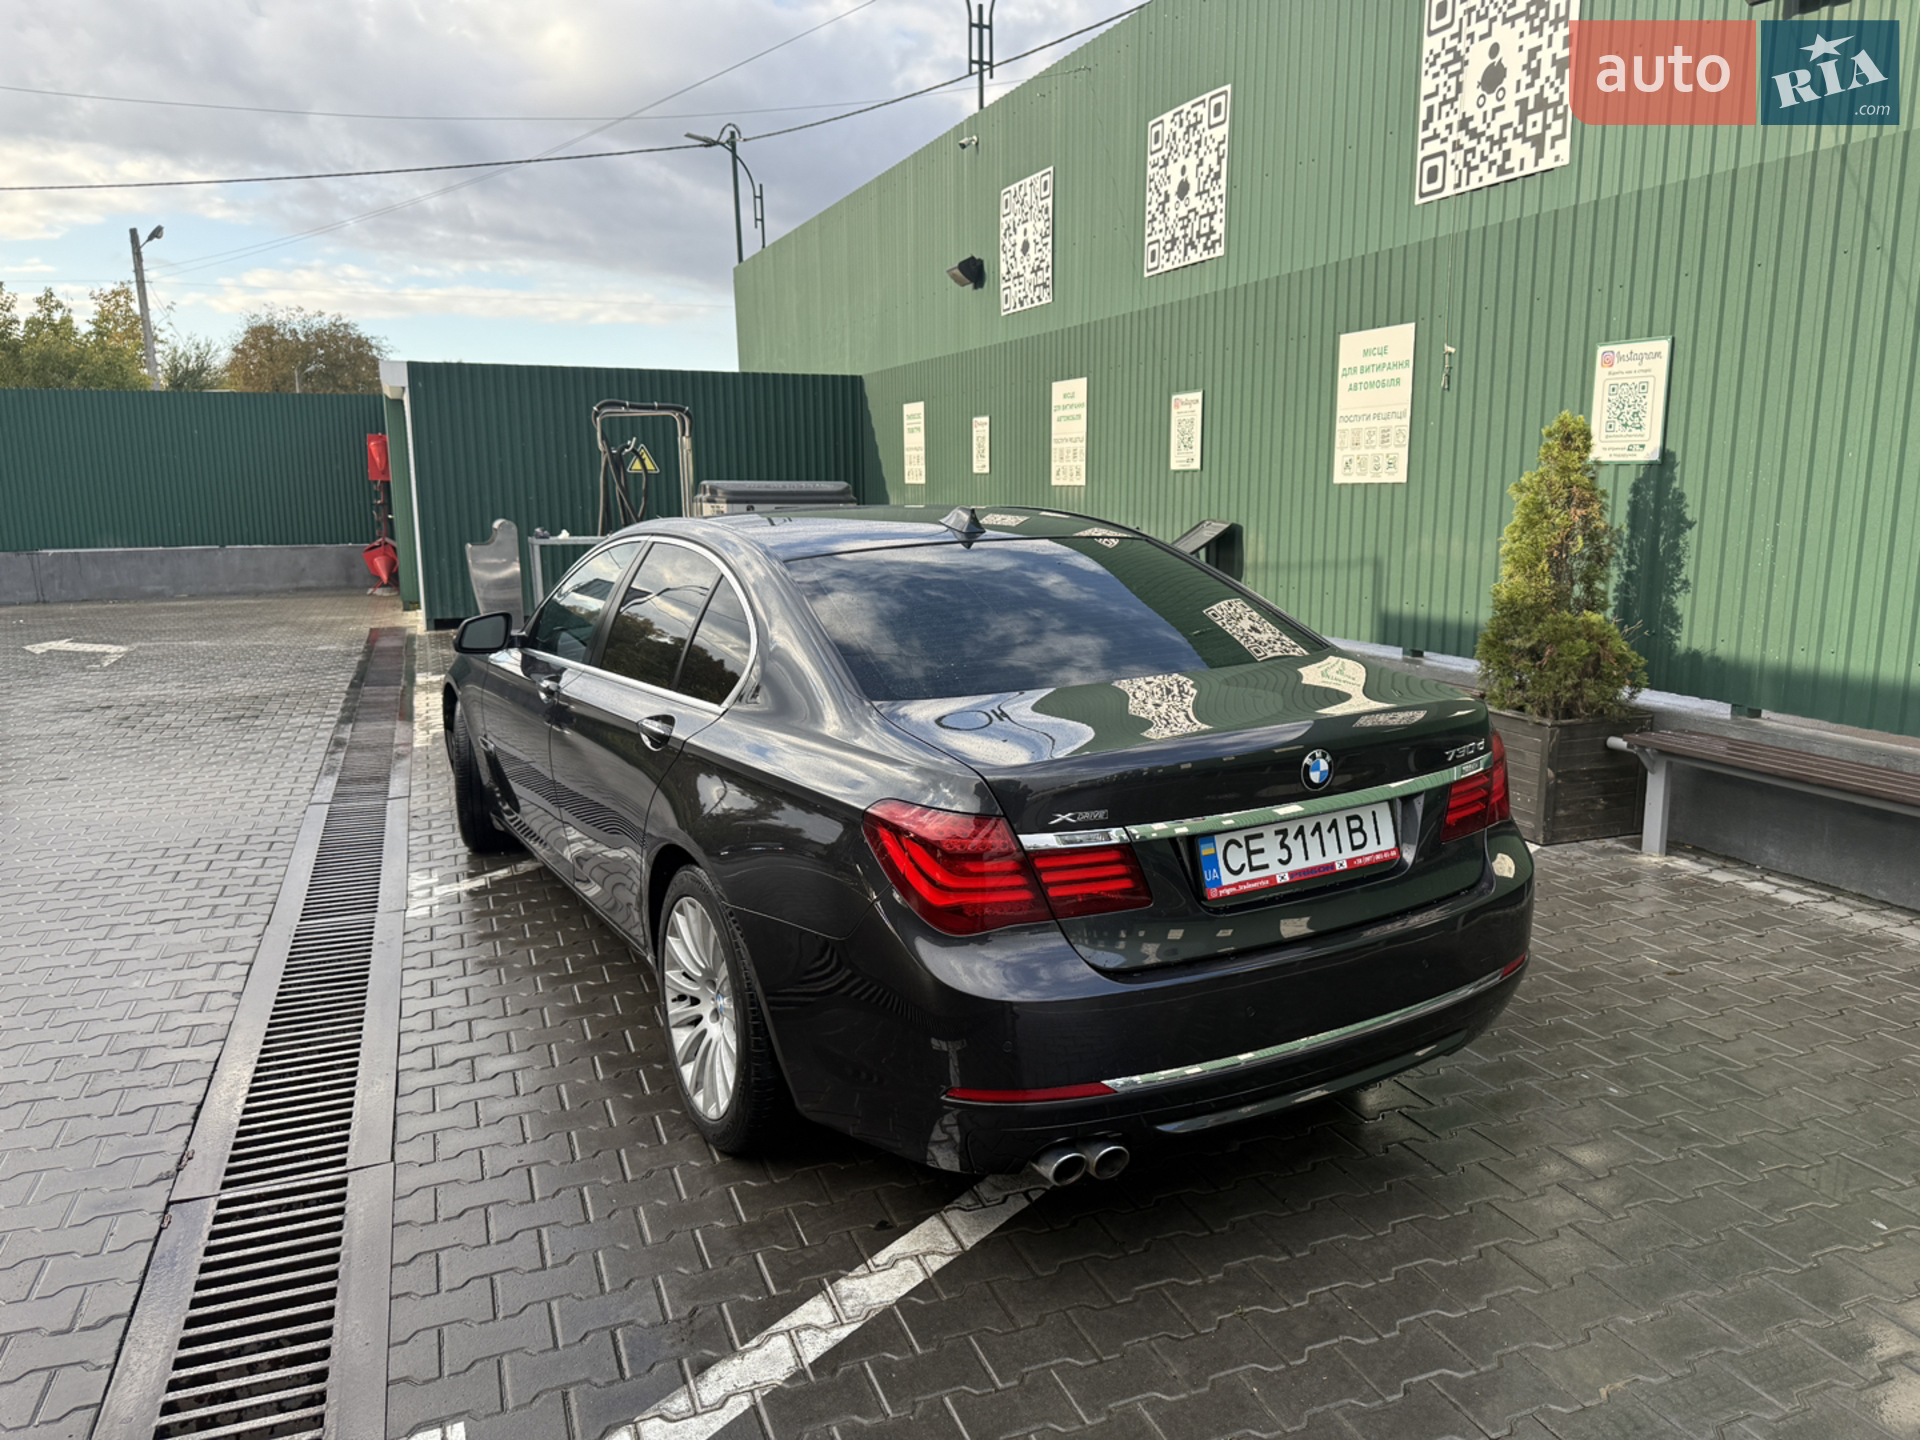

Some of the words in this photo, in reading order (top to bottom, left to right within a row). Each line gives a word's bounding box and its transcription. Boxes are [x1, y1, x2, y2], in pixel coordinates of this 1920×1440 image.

[1362, 345, 1389, 357] МІСЦЕ
[1616, 350, 1662, 366] Instagram
[1341, 366, 1358, 378] ДЛЯ
[1359, 359, 1410, 375] ВИТИРАННЯ
[1347, 377, 1401, 392] АВТОМОБІЛЯ
[1338, 413, 1371, 424] ПОСЛУГИ
[1372, 408, 1407, 421] РЕЦЕПЦІЇ
[1204, 869, 1220, 881] UA
